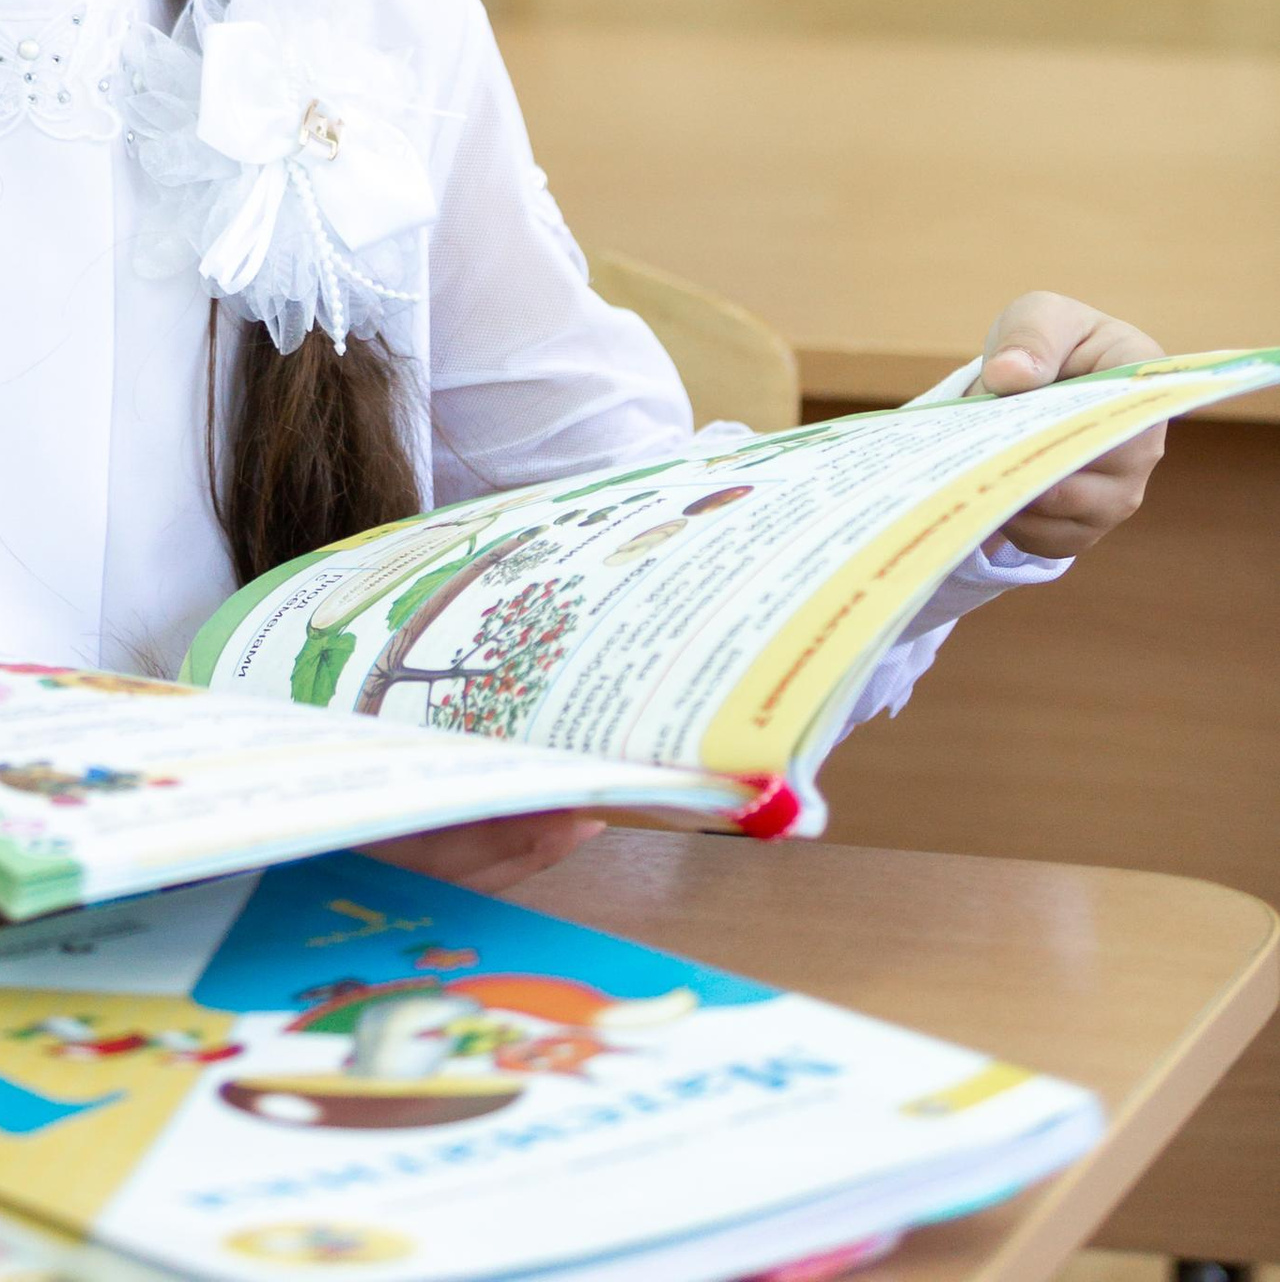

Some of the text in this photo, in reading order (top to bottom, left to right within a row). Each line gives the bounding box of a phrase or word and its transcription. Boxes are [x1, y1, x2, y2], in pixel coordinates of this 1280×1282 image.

[238, 573, 328, 679] с семенами
[292, 573, 344, 611] Плод
